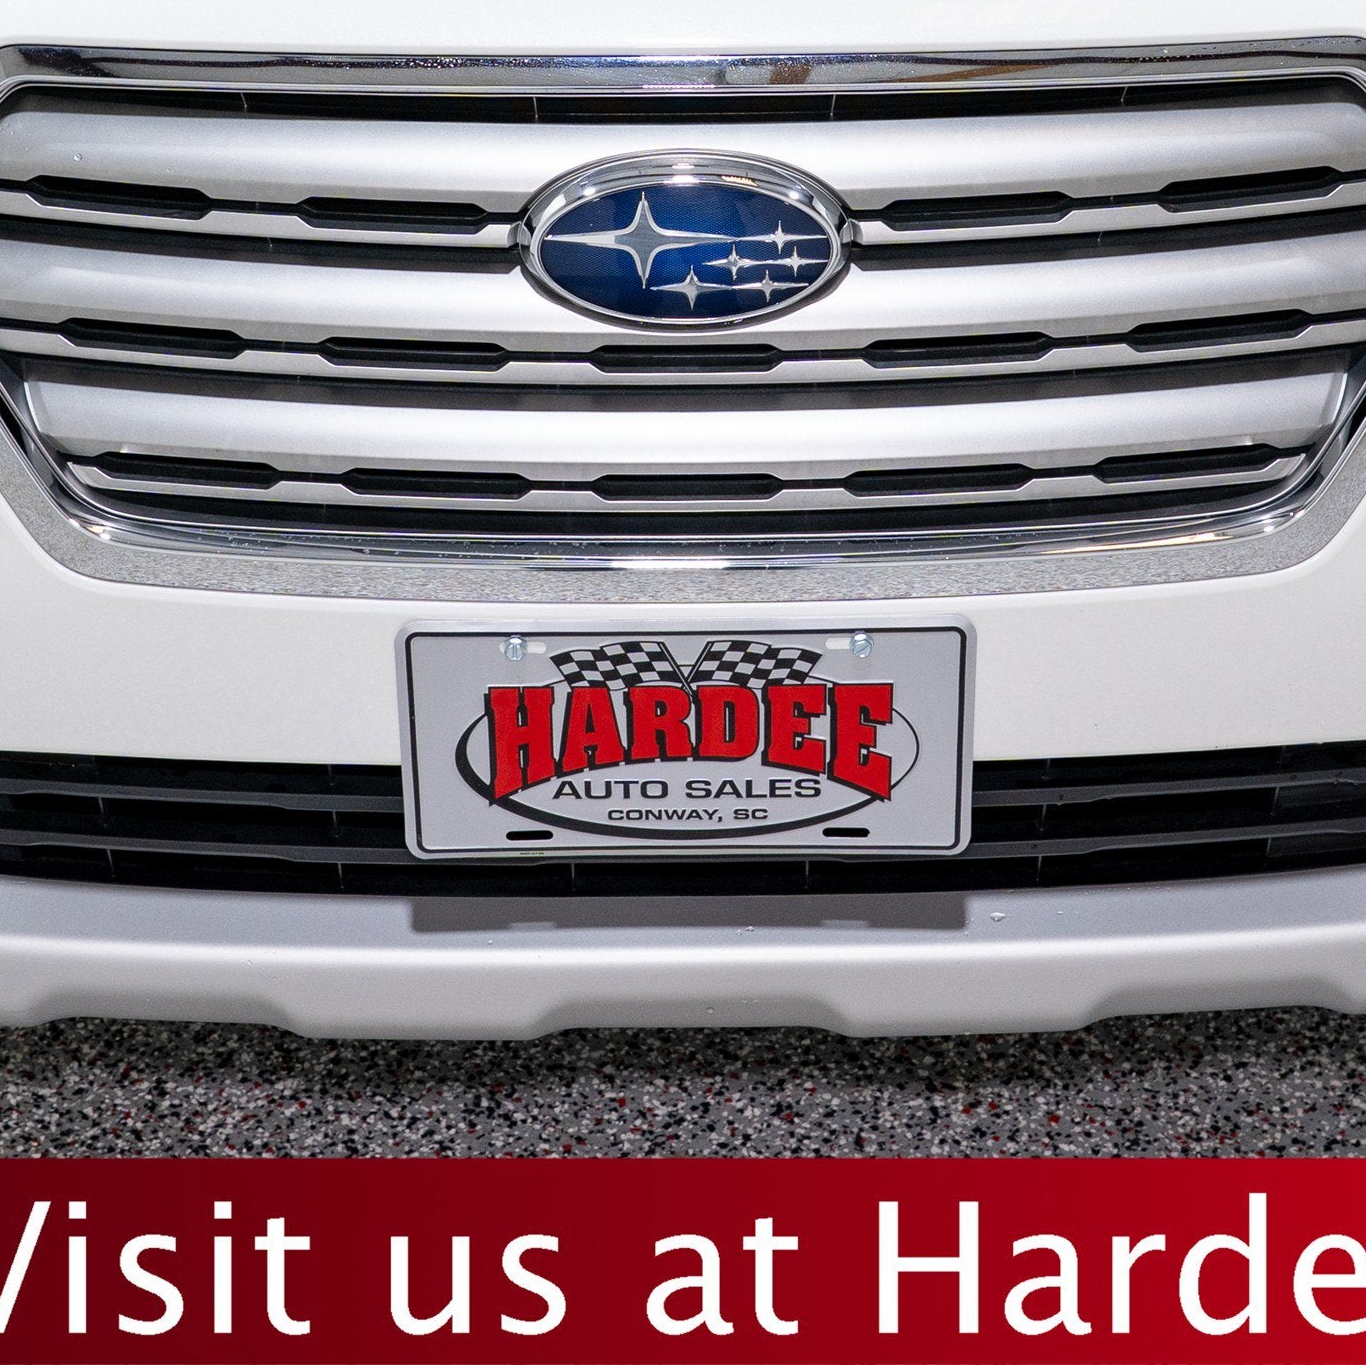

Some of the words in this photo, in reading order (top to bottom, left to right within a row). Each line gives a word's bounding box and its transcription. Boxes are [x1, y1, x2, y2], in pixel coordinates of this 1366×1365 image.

[484, 682, 895, 806] HARDEE
[552, 778, 670, 801] AUTO
[684, 777, 822, 799] SALES
[607, 808, 723, 823] CONWAY,
[733, 807, 769, 821] SC
